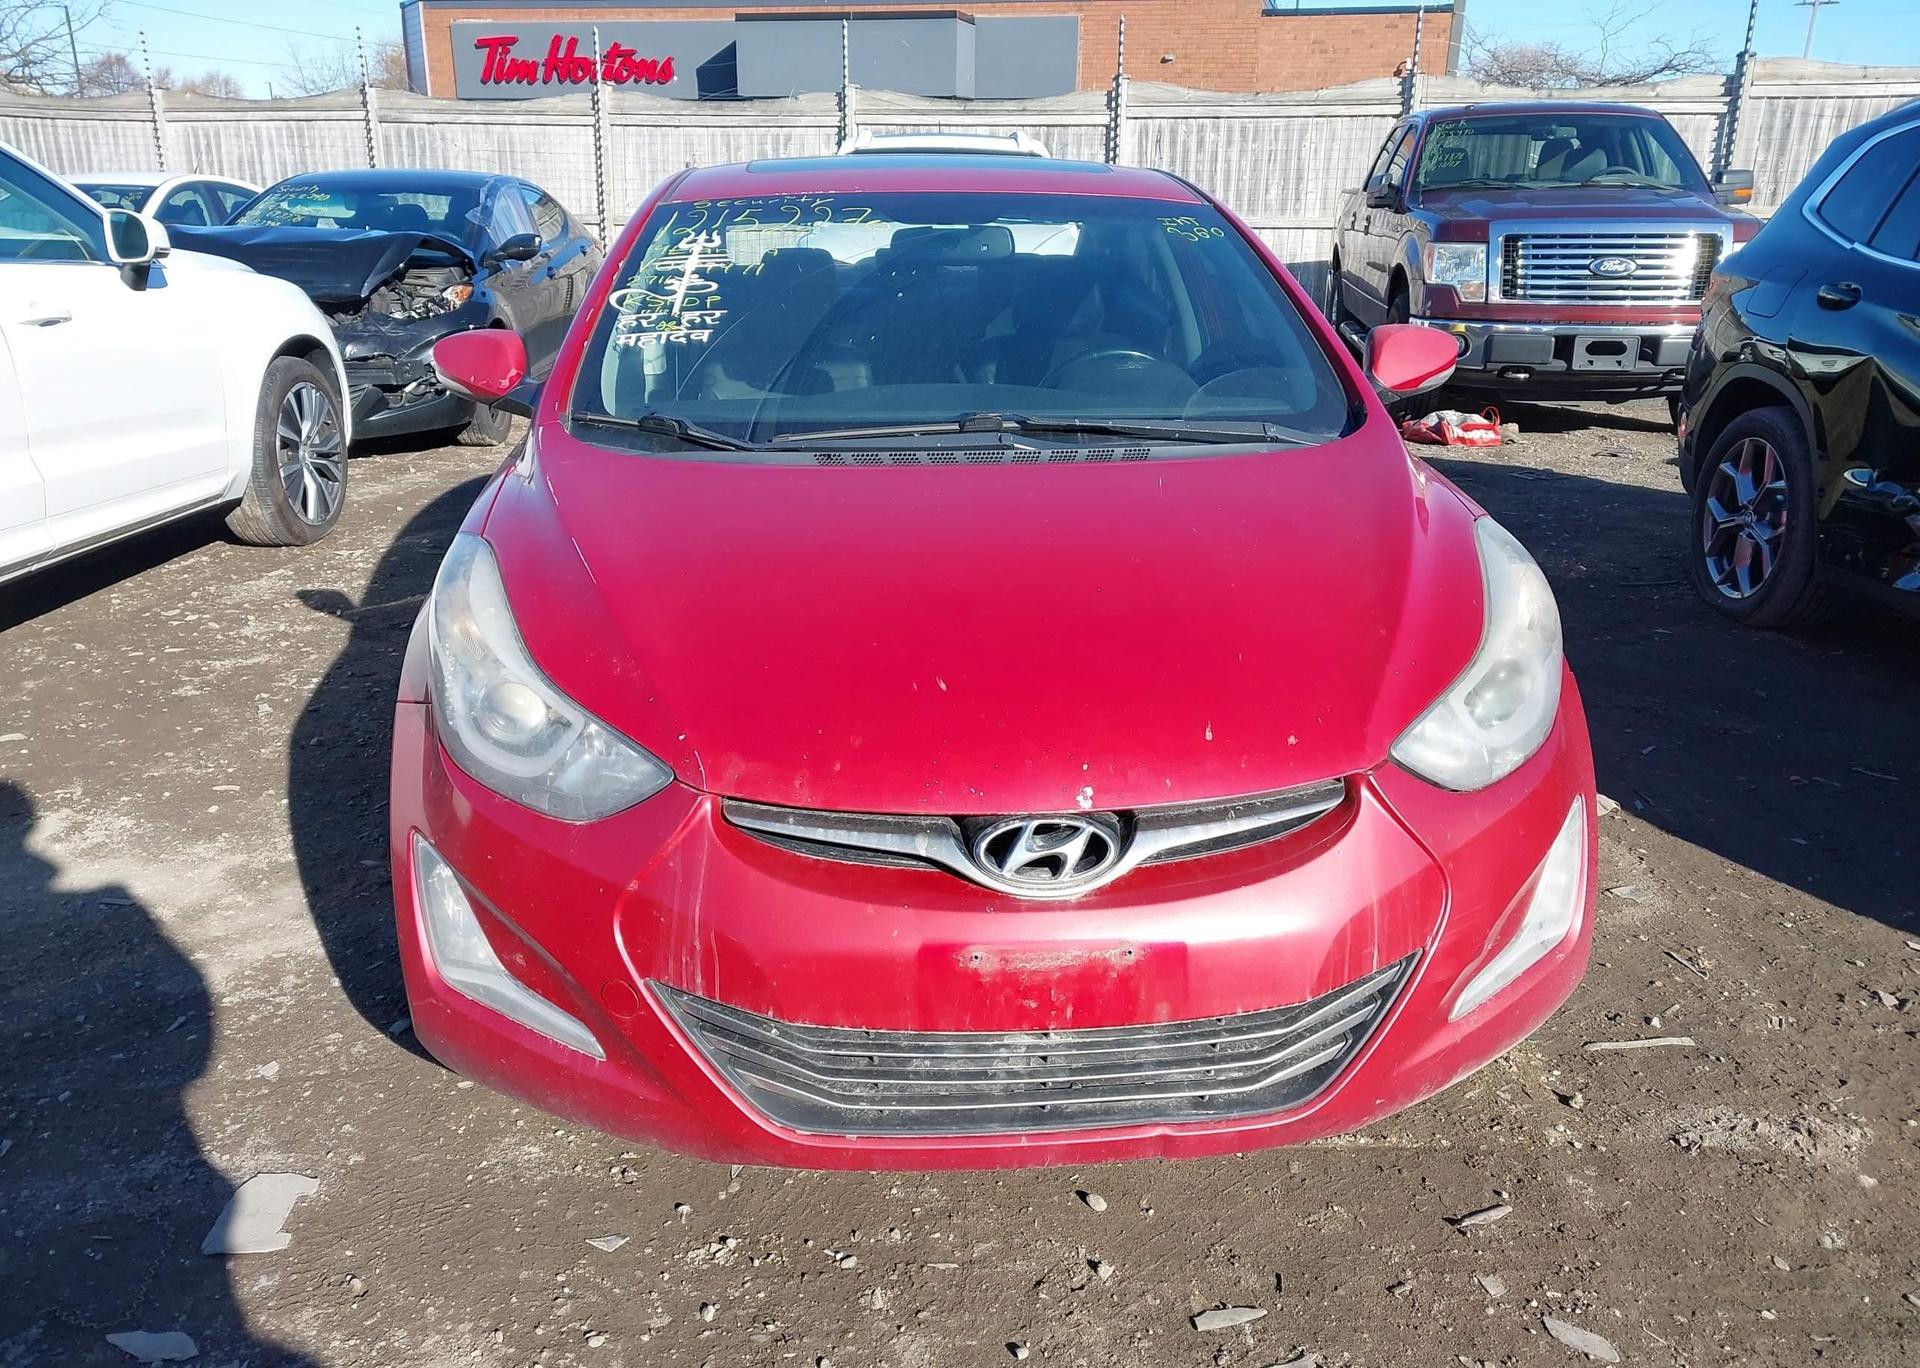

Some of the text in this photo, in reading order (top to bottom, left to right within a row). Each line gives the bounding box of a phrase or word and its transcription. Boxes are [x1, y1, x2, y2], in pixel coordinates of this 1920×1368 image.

[475, 33, 674, 85] Tim Hortons
[693, 195, 835, 208] Security
[1600, 259, 1626, 271] Ford
